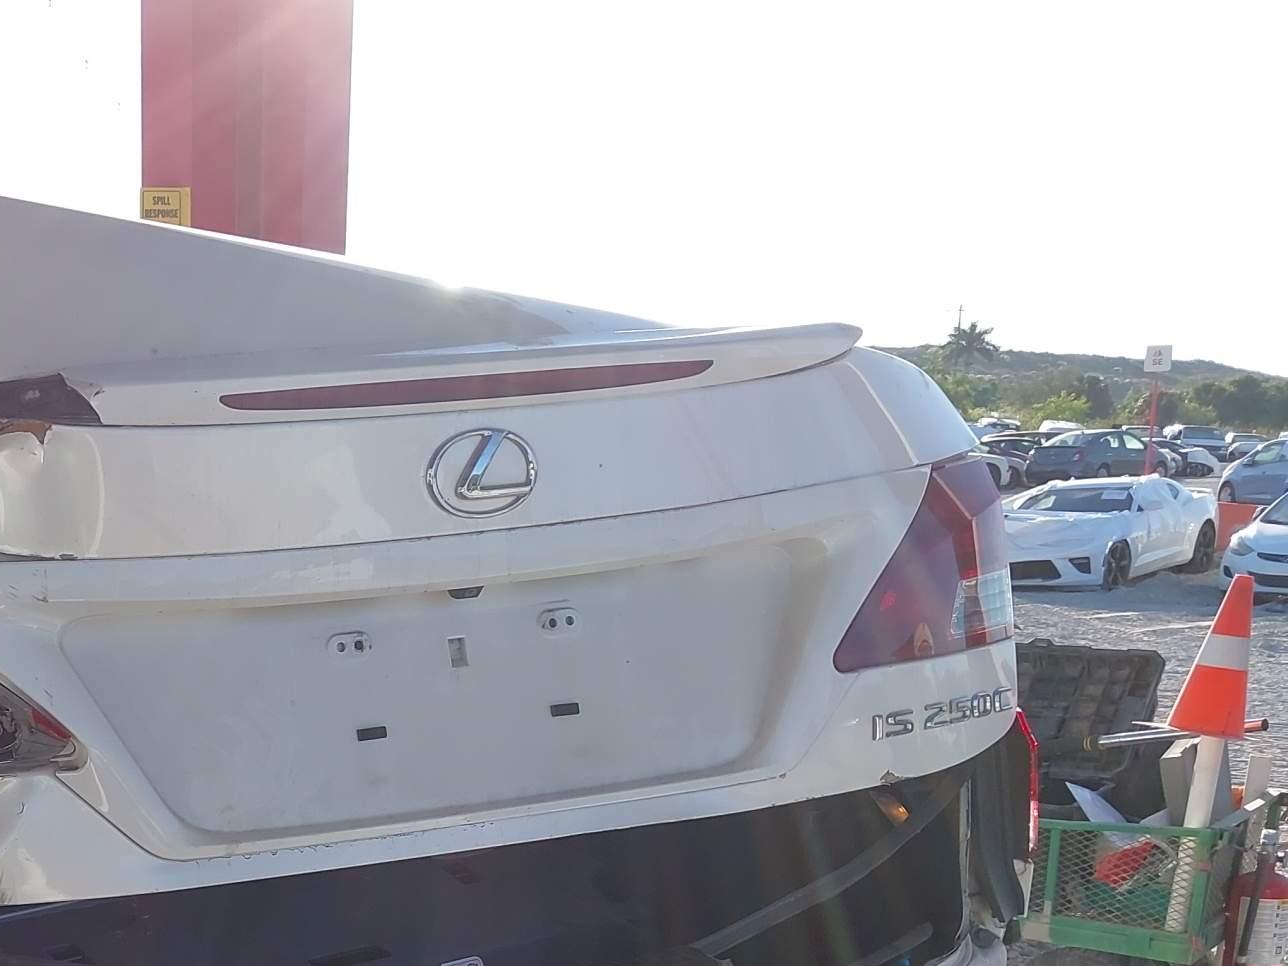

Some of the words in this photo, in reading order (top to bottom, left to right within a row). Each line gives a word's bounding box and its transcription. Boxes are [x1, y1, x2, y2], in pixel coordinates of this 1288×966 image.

[152, 196, 171, 205] SPILL
[145, 208, 179, 218] RESPONSE
[871, 708, 914, 741] IS
[923, 686, 1014, 731] 250C
